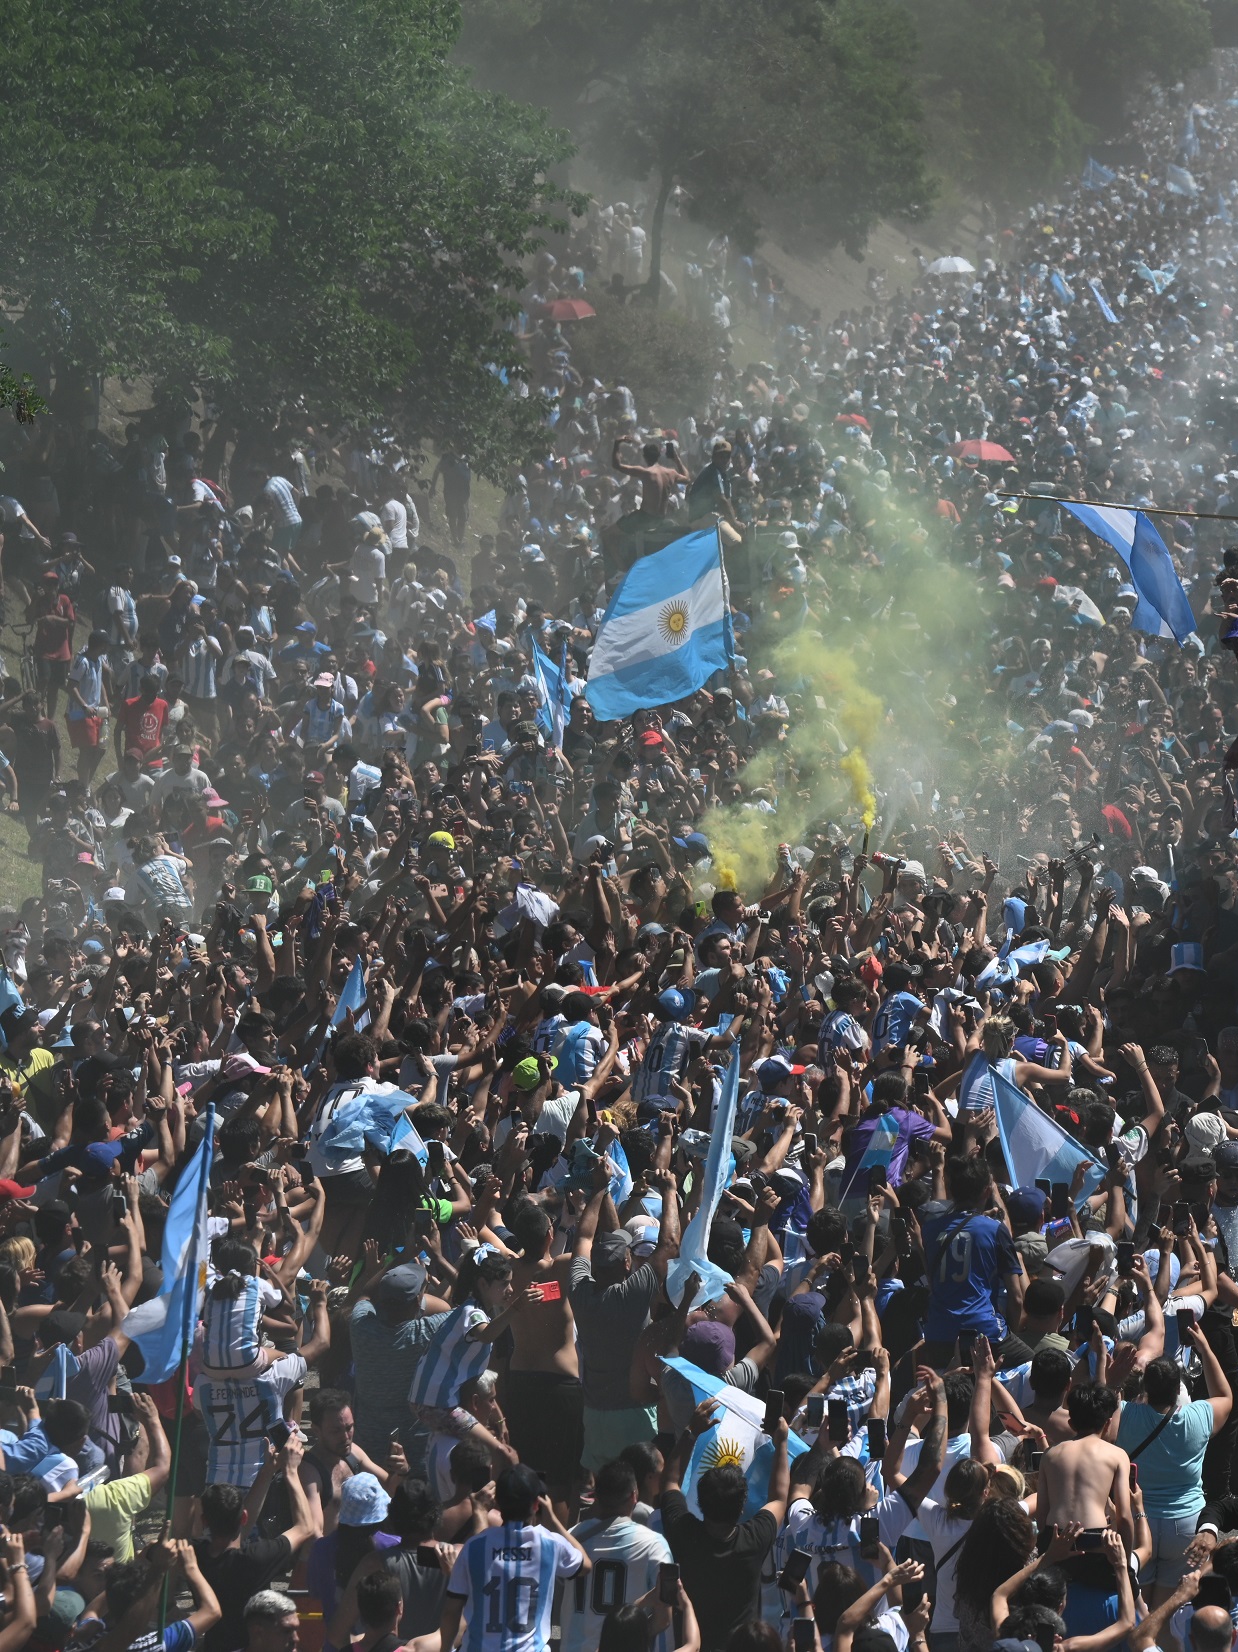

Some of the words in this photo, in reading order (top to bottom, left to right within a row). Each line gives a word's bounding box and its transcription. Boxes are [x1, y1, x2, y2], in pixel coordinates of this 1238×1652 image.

[255, 878, 266, 890] 13
[936, 1230, 973, 1283] 19
[207, 1399, 268, 1447] 24
[492, 1546, 533, 1562] MESSI
[482, 1575, 540, 1633] 10
[574, 1557, 628, 1616] 10
